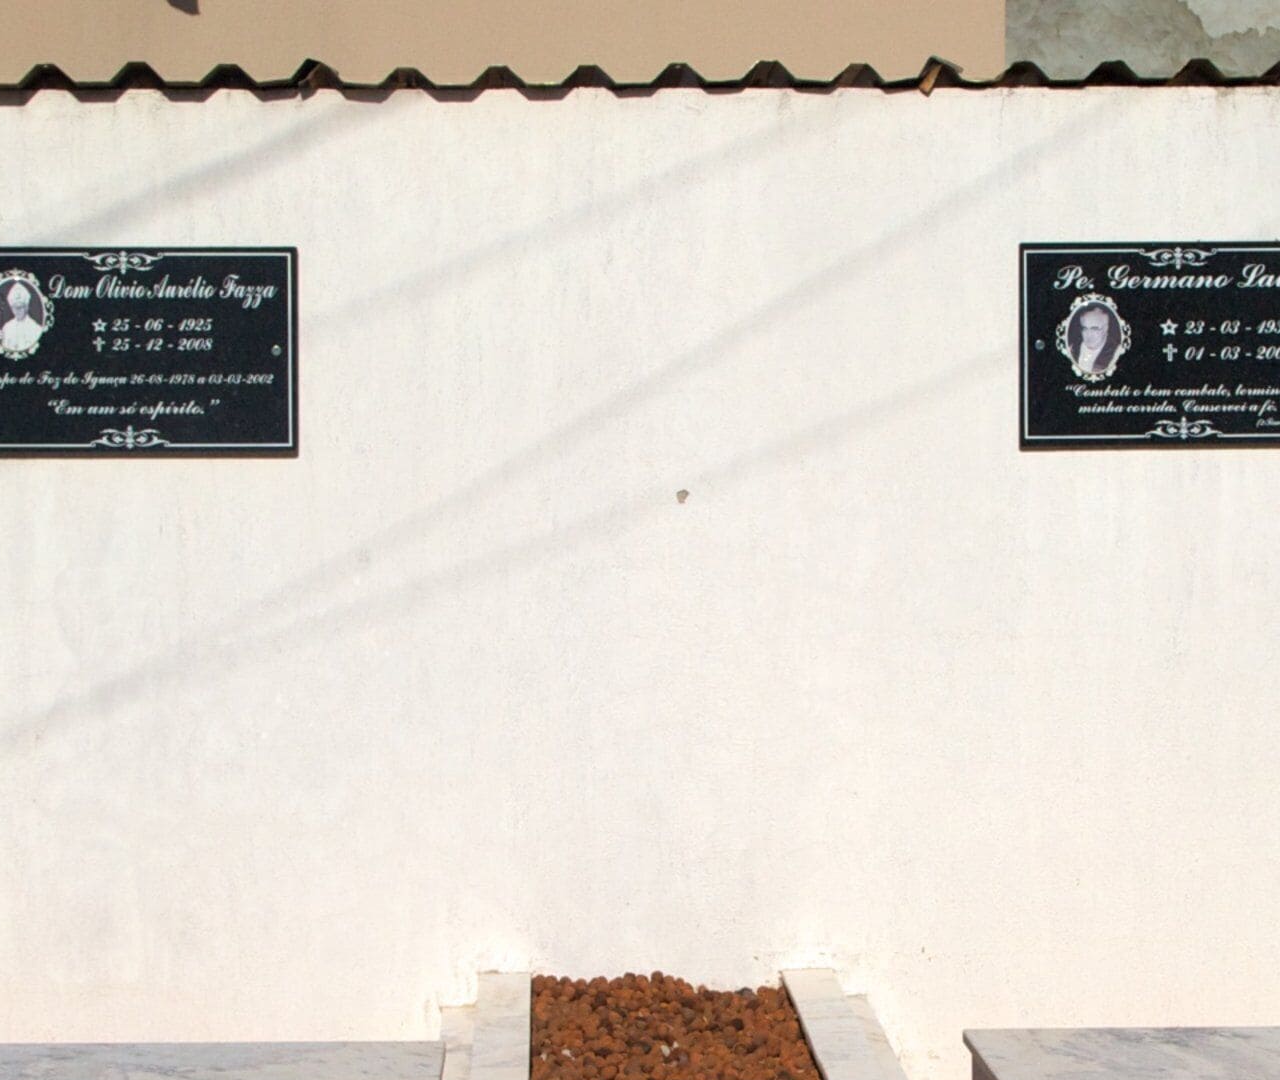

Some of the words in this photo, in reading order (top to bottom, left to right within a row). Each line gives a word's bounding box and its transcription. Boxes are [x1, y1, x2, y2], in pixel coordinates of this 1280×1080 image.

[1054, 265, 1095, 289] Pe.
[1107, 265, 1232, 289] Germano
[48, 274, 91, 299] Dom
[220, 274, 276, 309] Fazza
[112, 319, 130, 331] 25
[144, 319, 164, 331] 06
[178, 319, 213, 331] 1925
[1184, 320, 1205, 334] 23
[1220, 320, 1241, 334] 03
[112, 338, 130, 351] 25
[146, 338, 164, 351] 12
[177, 338, 213, 351] 2008
[1184, 346, 1205, 360] 01
[1220, 346, 1241, 360] 03
[37, 370, 61, 390] Foz
[1144, 384, 1171, 397] bom
[1078, 401, 1123, 414] minha
